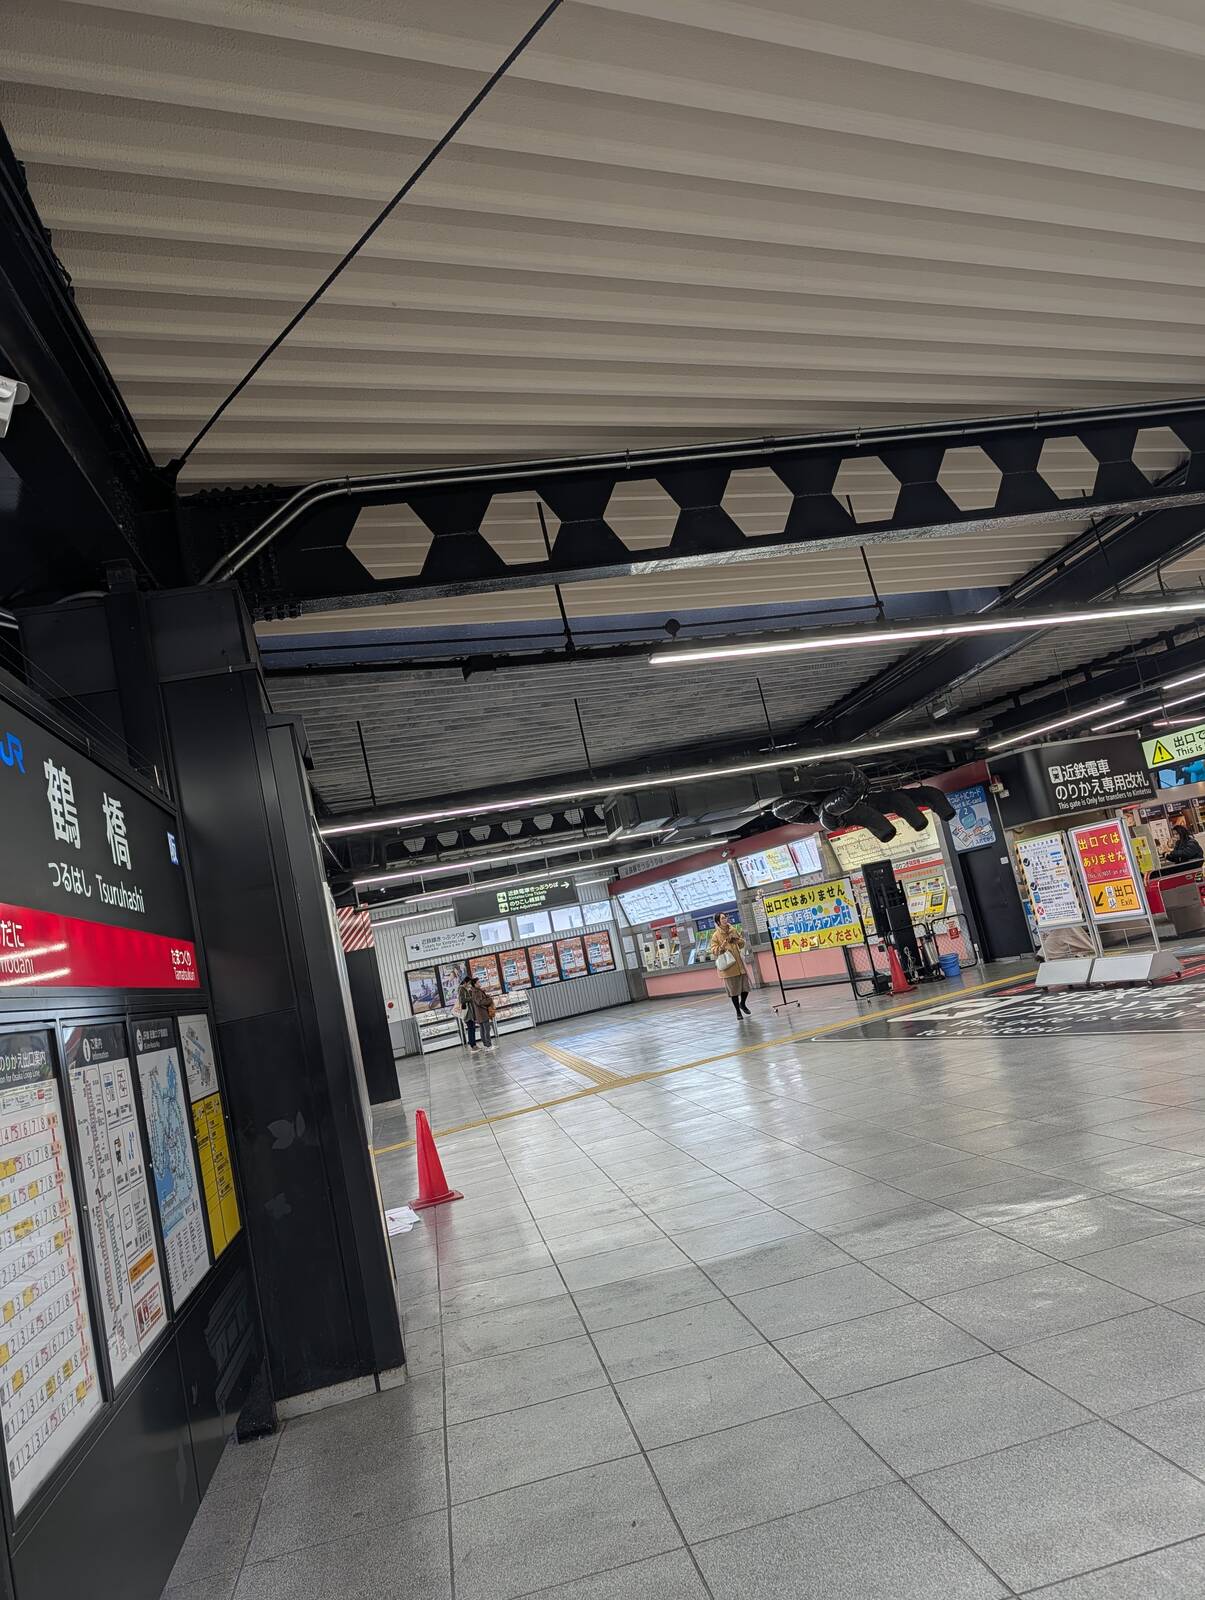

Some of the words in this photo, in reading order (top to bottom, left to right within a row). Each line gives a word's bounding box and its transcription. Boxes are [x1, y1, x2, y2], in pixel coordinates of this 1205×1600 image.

[1176, 746, 1195, 757] This
[1195, 744, 1203, 752] is
[1061, 759, 1111, 781] 近鉄電車
[1055, 770, 1150, 800] のりかえ専用改札
[1058, 802, 1069, 810] This
[1069, 800, 1081, 810] gate
[1080, 798, 1086, 806] is
[1086, 797, 1098, 806] Only
[1105, 792, 1127, 802] transfers
[1132, 788, 1152, 797] Kintetsu
[1077, 832, 1121, 851] 出口では
[1083, 850, 1126, 868] ありません
[48, 862, 92, 897] つるはし
[96, 874, 145, 913] Tsuruhashi
[765, 884, 845, 914] 出口ではありません
[1113, 884, 1134, 898] 出口
[1120, 898, 1133, 907] Exit
